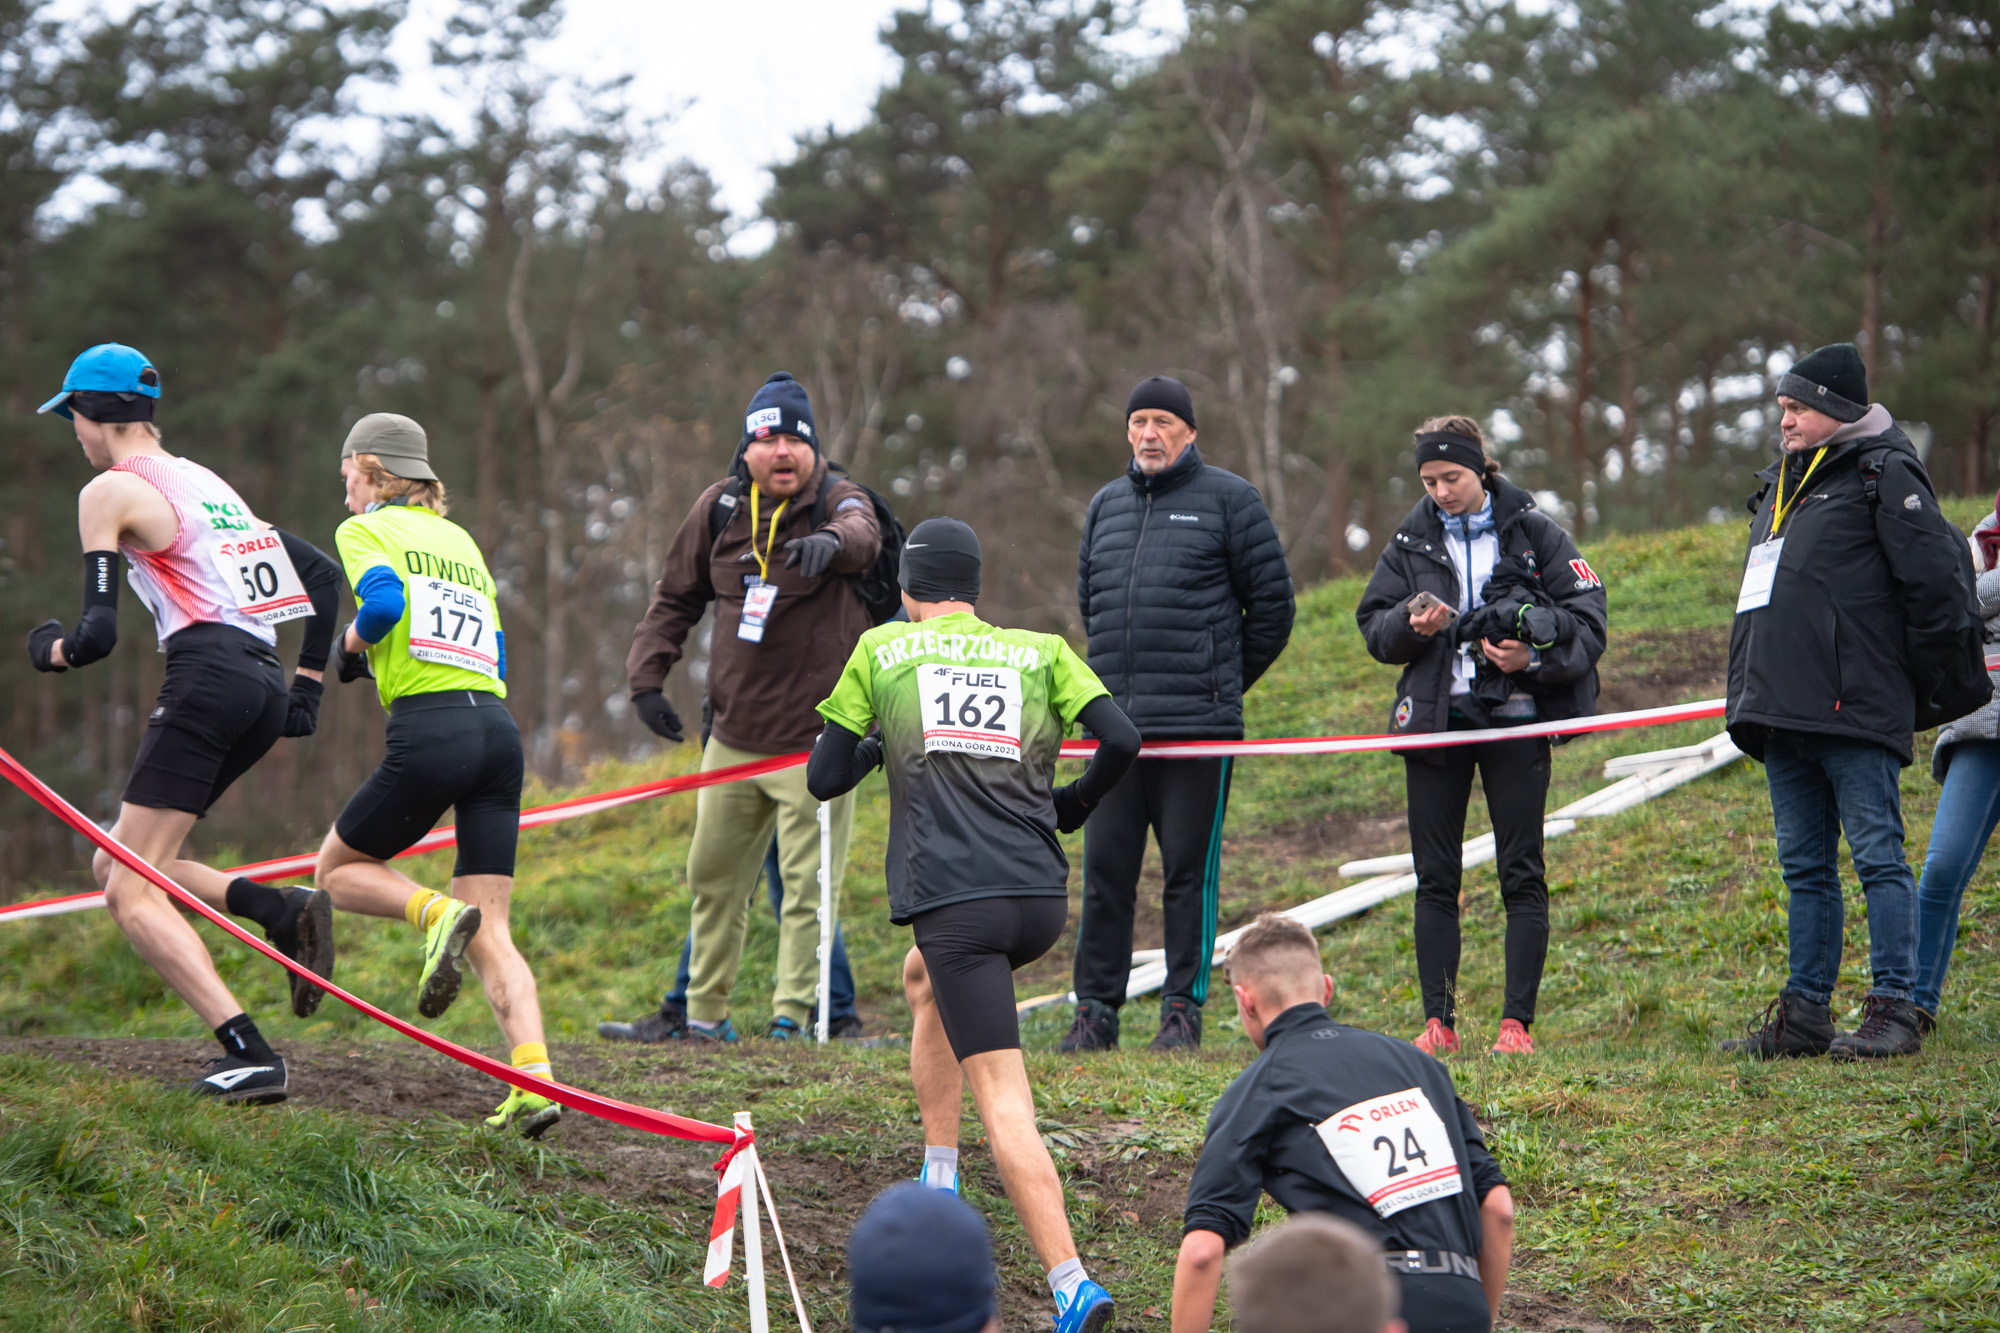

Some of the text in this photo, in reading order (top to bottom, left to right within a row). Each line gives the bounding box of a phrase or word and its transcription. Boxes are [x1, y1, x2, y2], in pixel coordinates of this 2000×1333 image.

[97, 556, 108, 593] KIPRUN
[240, 562, 279, 602] 50
[286, 605, 309, 615] 2023
[428, 581, 483, 612] 4F FUEL
[430, 606, 483, 647] 177
[416, 649, 453, 661] ZIELONA
[454, 655, 477, 667] GÓRA
[477, 661, 493, 674] 2023
[874, 629, 1040, 671] GRZEGRZÓŁKA
[933, 667, 1007, 690] 4F FUEL
[934, 692, 1007, 732] 162
[925, 739, 1016, 756] ZIELONA GÓRA 2023
[1369, 1097, 1421, 1122] ORLEN
[1373, 1127, 1429, 1178] 24
